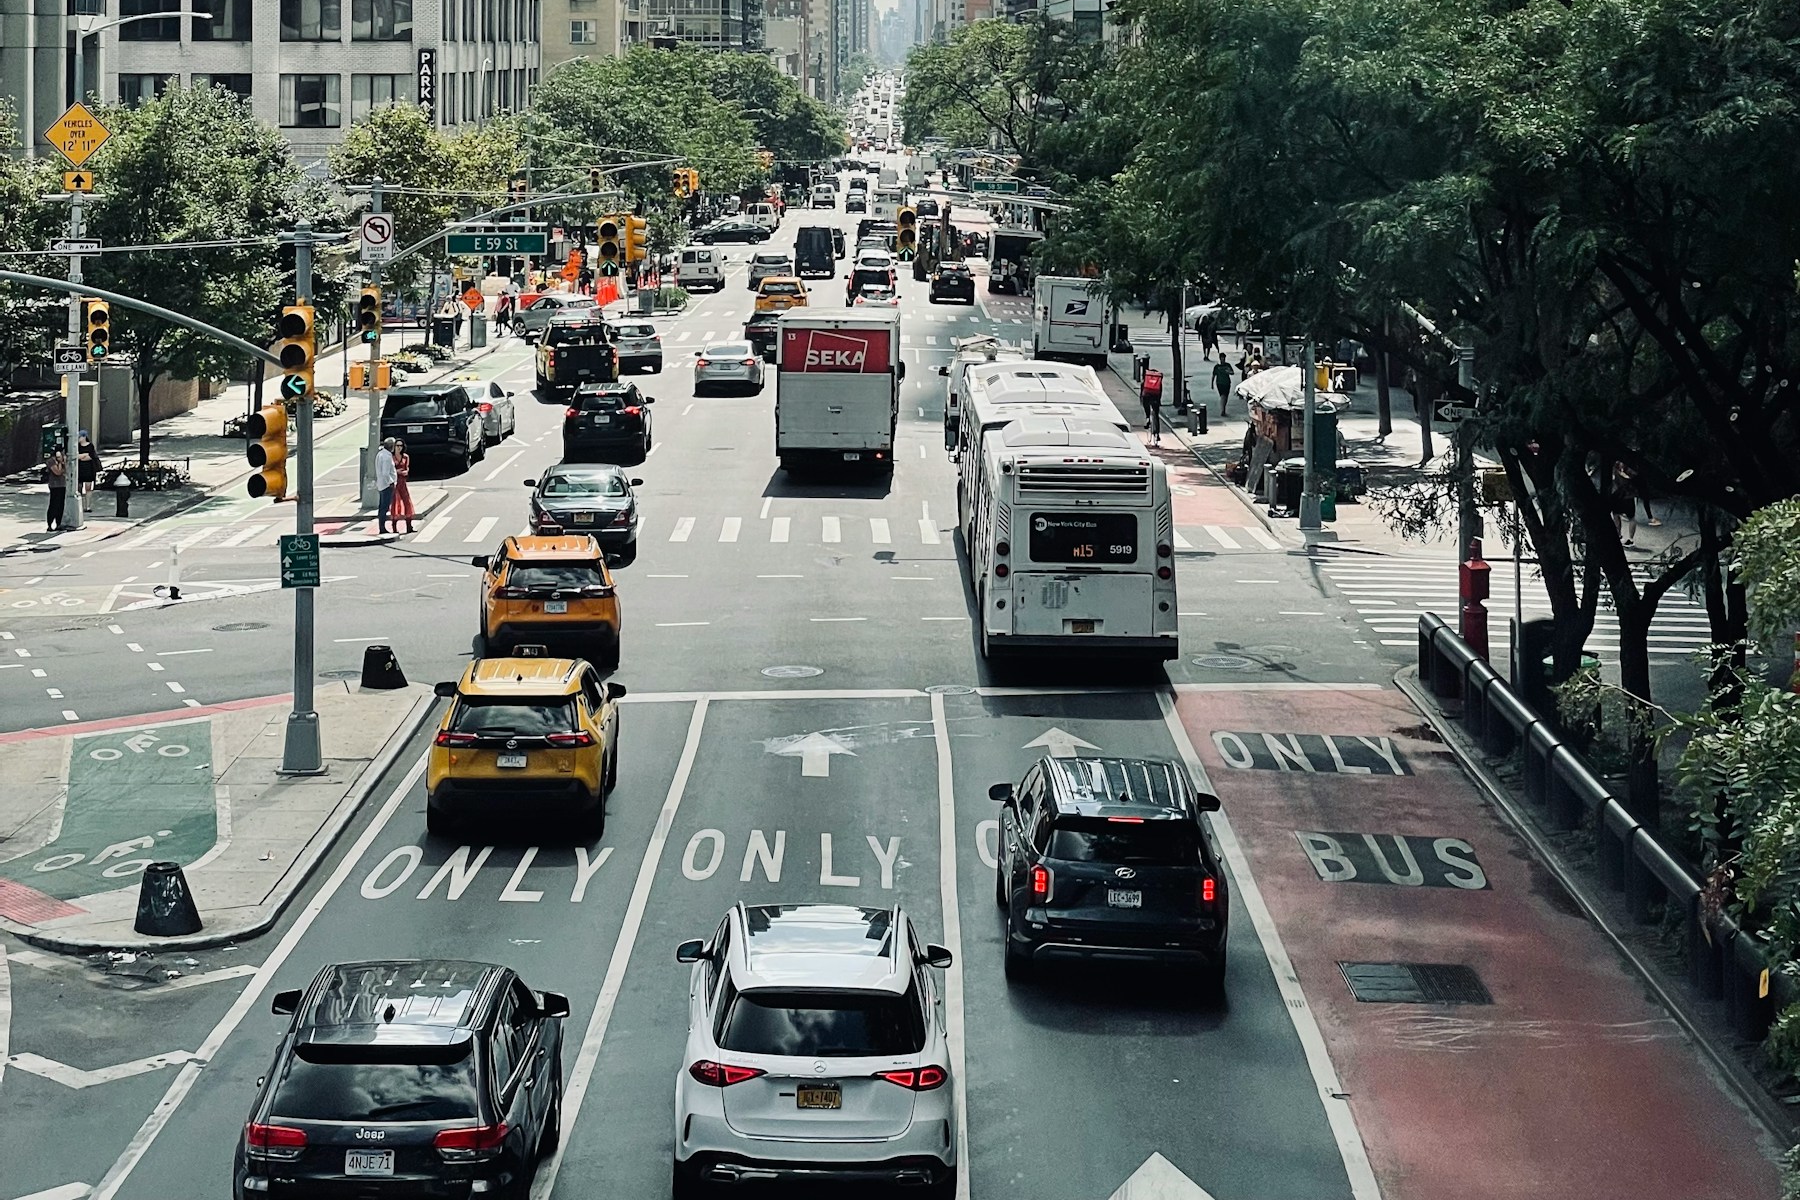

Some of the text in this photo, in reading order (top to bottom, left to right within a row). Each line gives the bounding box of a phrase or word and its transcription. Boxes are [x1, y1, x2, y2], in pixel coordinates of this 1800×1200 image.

[420, 52, 431, 98] PARK
[64, 120, 92, 128] VEHICLES
[474, 238, 519, 251] E 59 St
[787, 333, 797, 341] 13
[806, 349, 865, 366] SEKA
[1109, 545, 1133, 554] 5919
[1212, 731, 1405, 776] ONLY
[681, 828, 901, 889] ONLY
[1294, 831, 1487, 890] BUS
[360, 845, 615, 903] ONLY
[355, 1127, 385, 1141] Jeep
[348, 1156, 391, 1169] 4NJE 71
